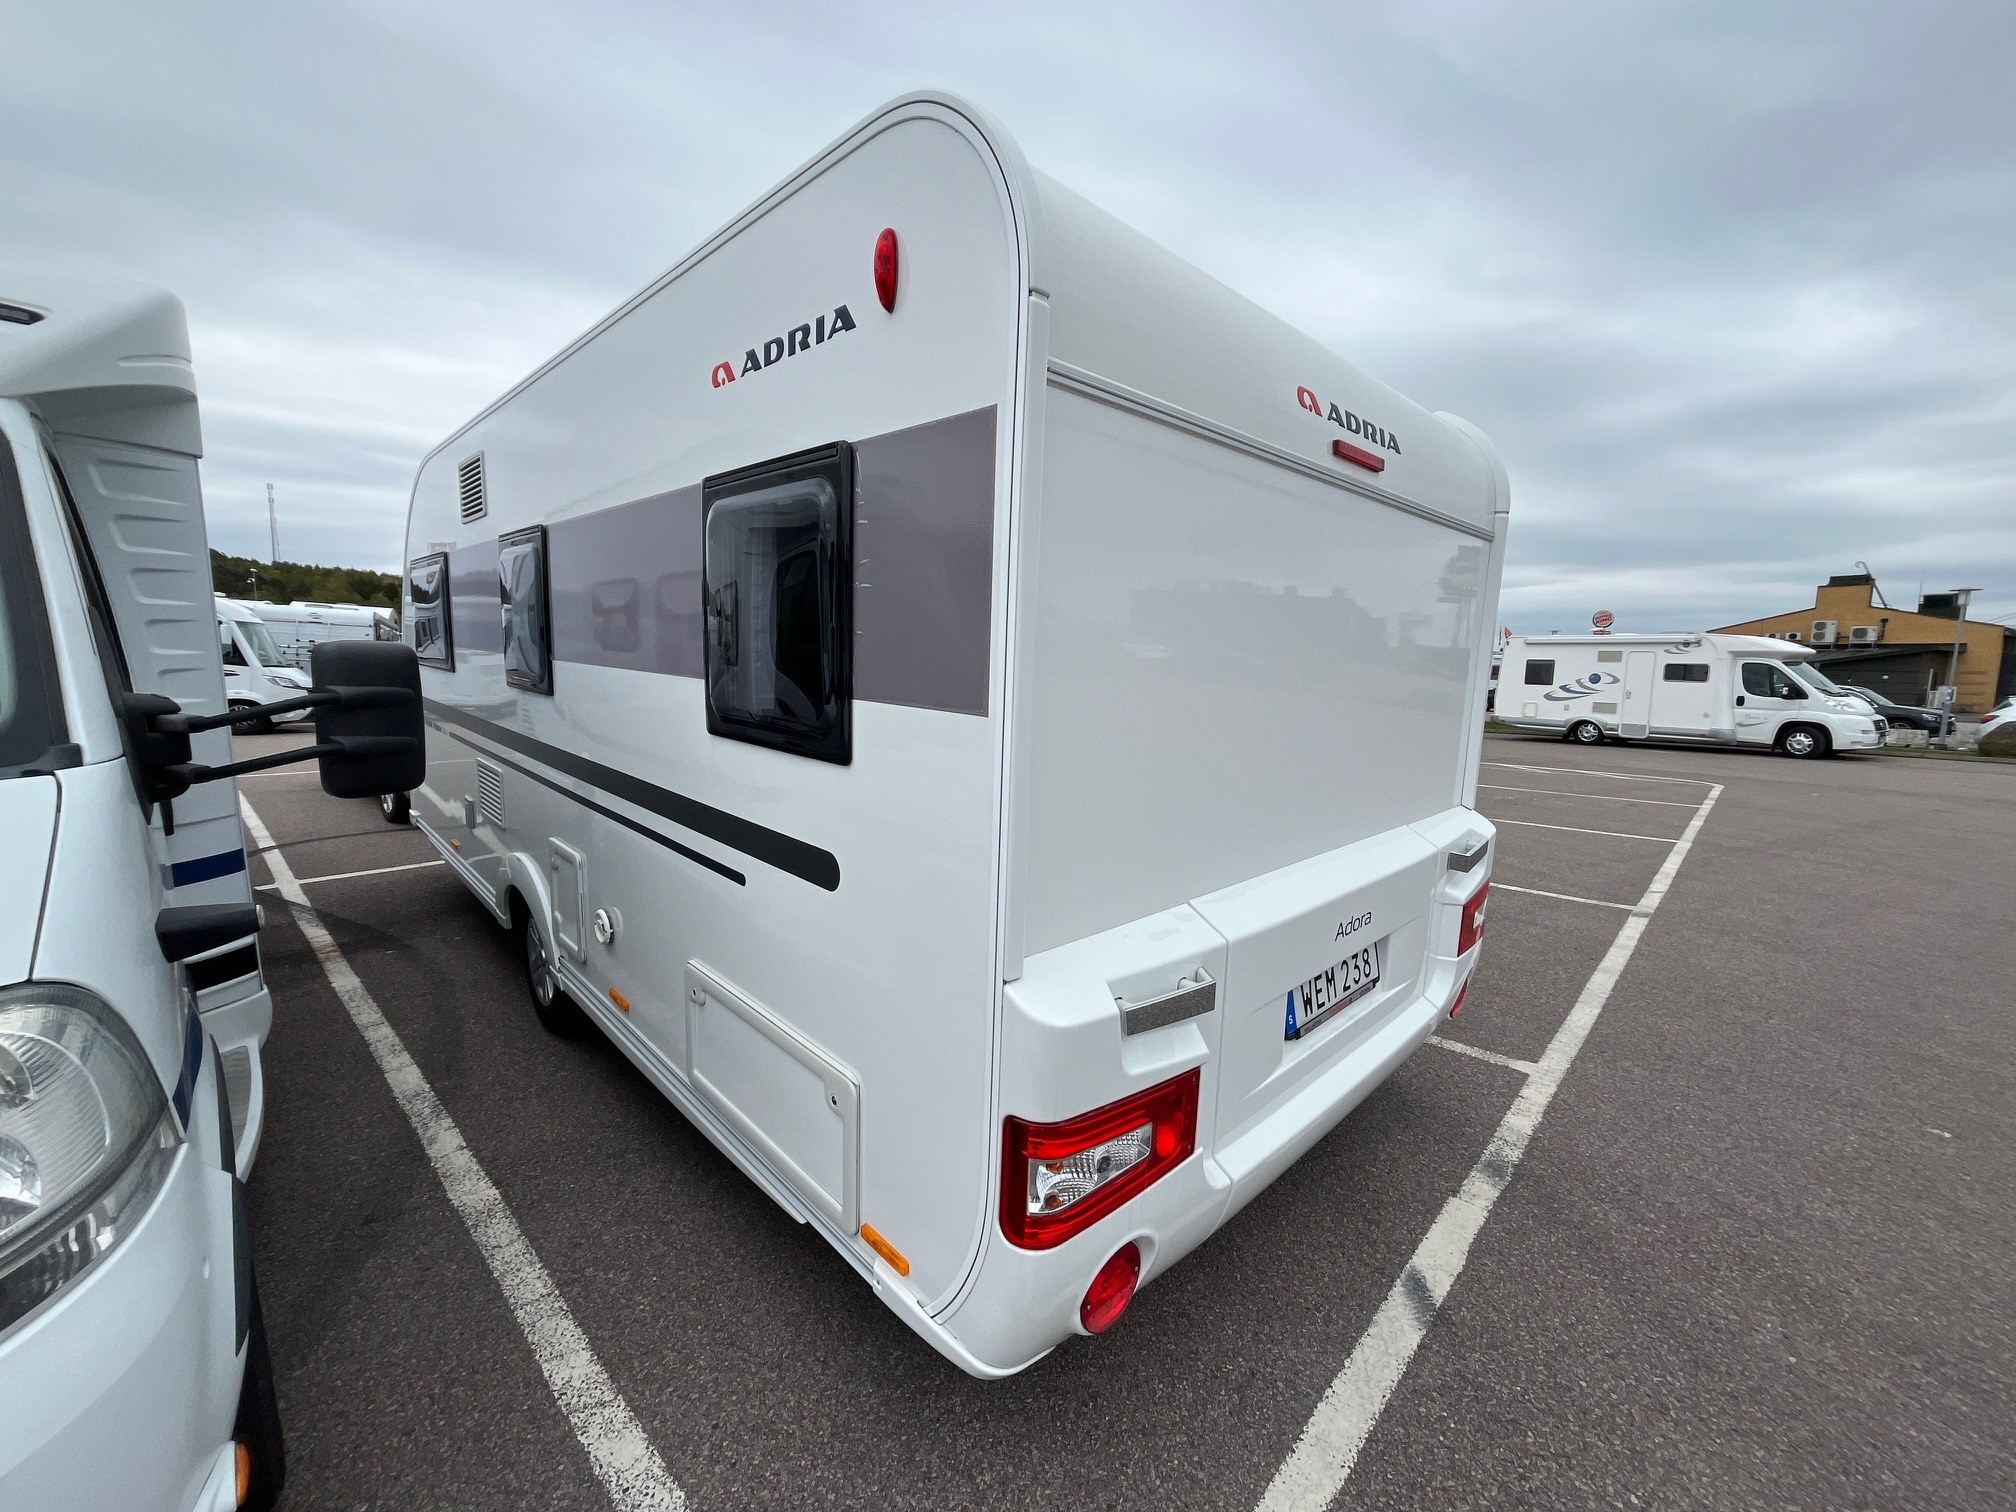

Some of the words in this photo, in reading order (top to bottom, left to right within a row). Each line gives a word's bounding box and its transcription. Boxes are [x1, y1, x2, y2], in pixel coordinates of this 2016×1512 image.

[740, 304, 857, 378] ADRIA
[1327, 401, 1401, 455] ADRIA
[1334, 911, 1372, 942] Adora
[1300, 966, 1337, 1018] WEM
[1340, 948, 1372, 993] 238
[1288, 1015, 1293, 1025] S
